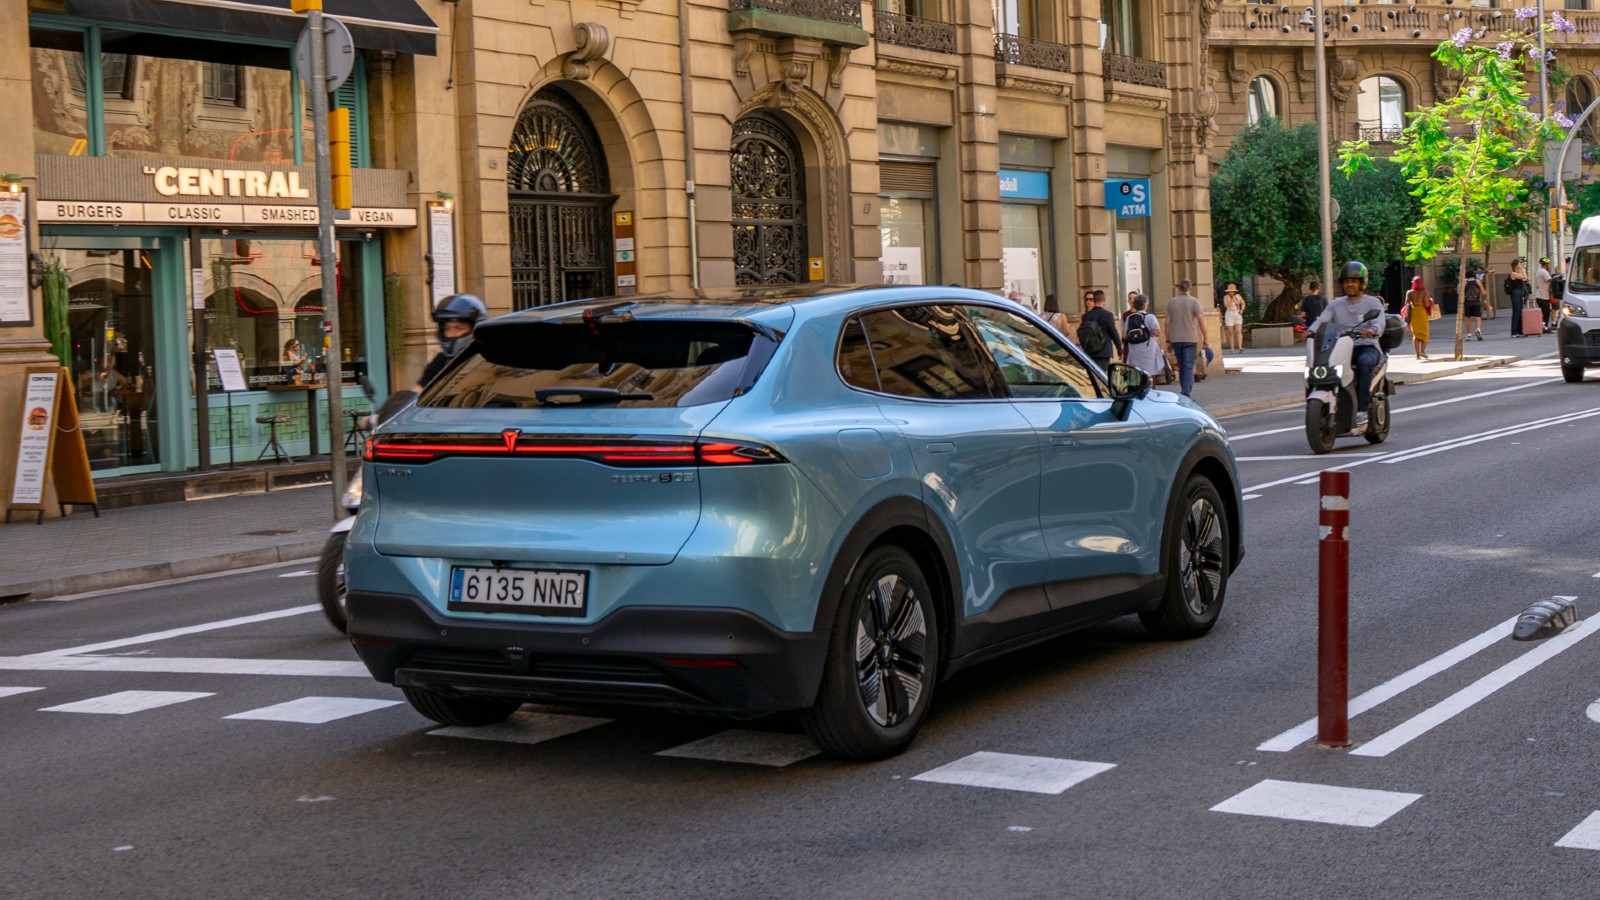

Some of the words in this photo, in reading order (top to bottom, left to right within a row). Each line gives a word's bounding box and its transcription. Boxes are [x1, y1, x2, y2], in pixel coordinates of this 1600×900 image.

[154, 166, 309, 198] CENTRAL
[1122, 185, 1130, 193] B
[1132, 184, 1146, 203] S
[57, 204, 123, 218] BURGERS
[168, 207, 222, 220] CLASSIC
[261, 208, 317, 221] SMASHED
[357, 211, 394, 222] VEGAN
[1121, 204, 1146, 216] ATM
[466, 575, 525, 602] 6135
[533, 577, 579, 606] NNR
